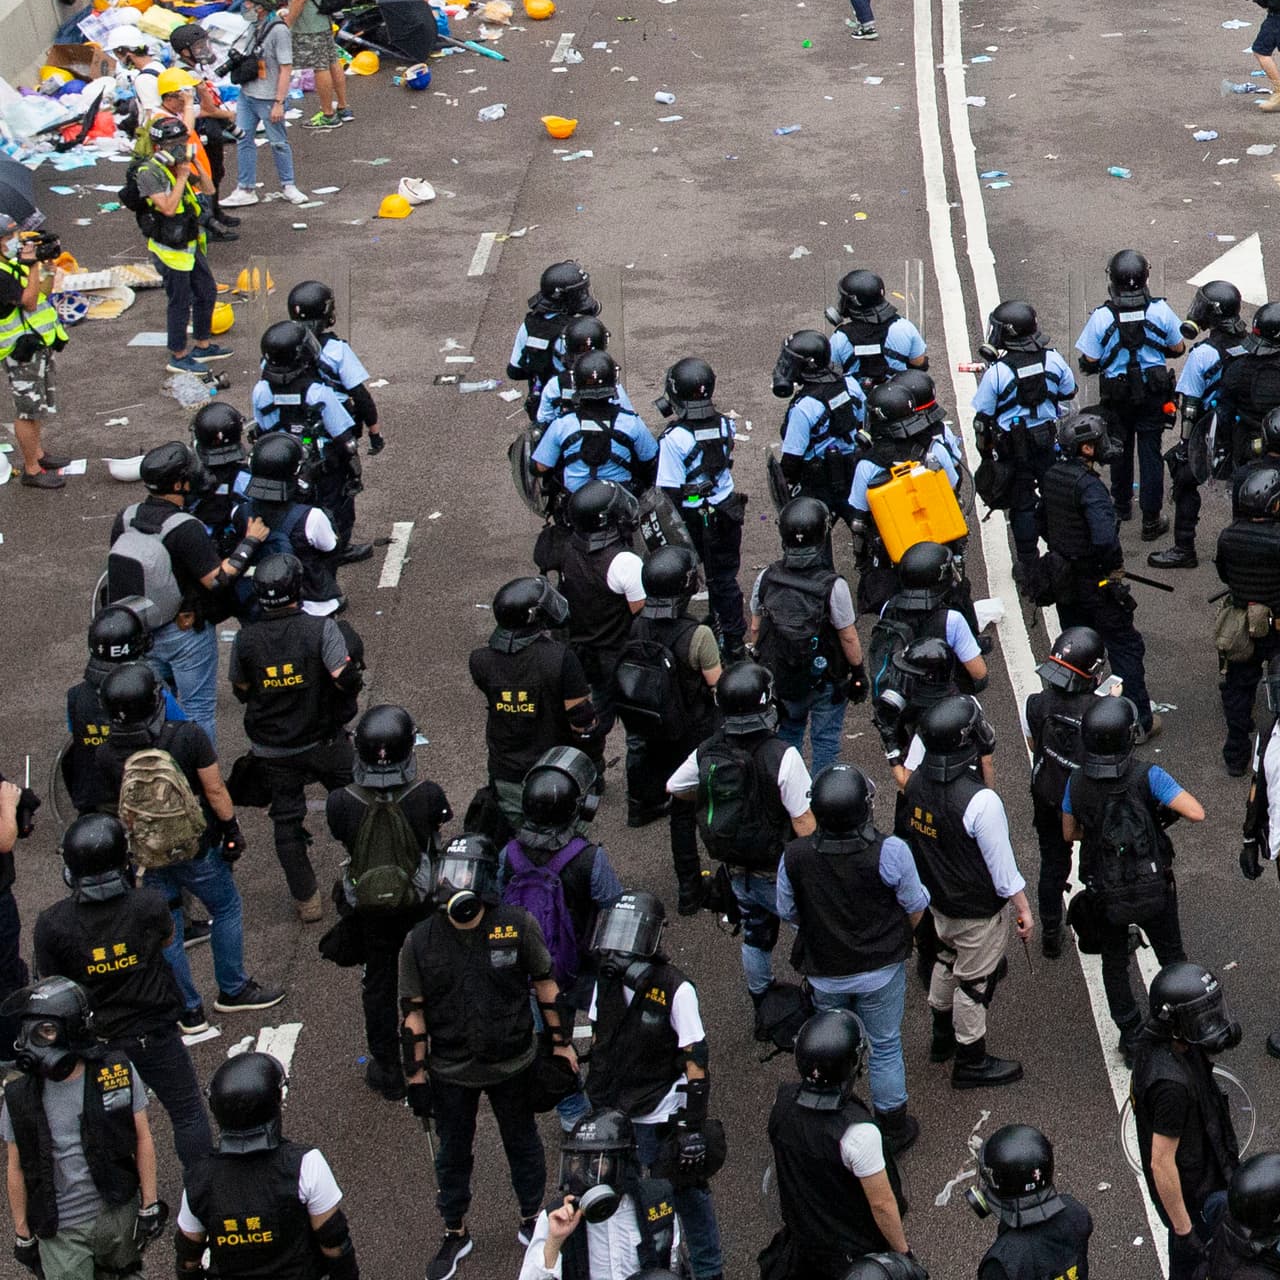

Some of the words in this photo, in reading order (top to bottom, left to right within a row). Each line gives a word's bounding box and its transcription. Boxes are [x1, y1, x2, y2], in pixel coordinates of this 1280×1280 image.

[649, 511, 667, 546] LICE
[109, 643, 130, 657] E4
[264, 675, 303, 689] POLICE
[495, 703, 535, 713] POLICE
[909, 818, 937, 839] POLICE
[488, 931, 518, 940] POLICE
[87, 954, 139, 975] POLICE
[96, 1069, 129, 1084] POLICE
[216, 1229, 273, 1247] POLICE
